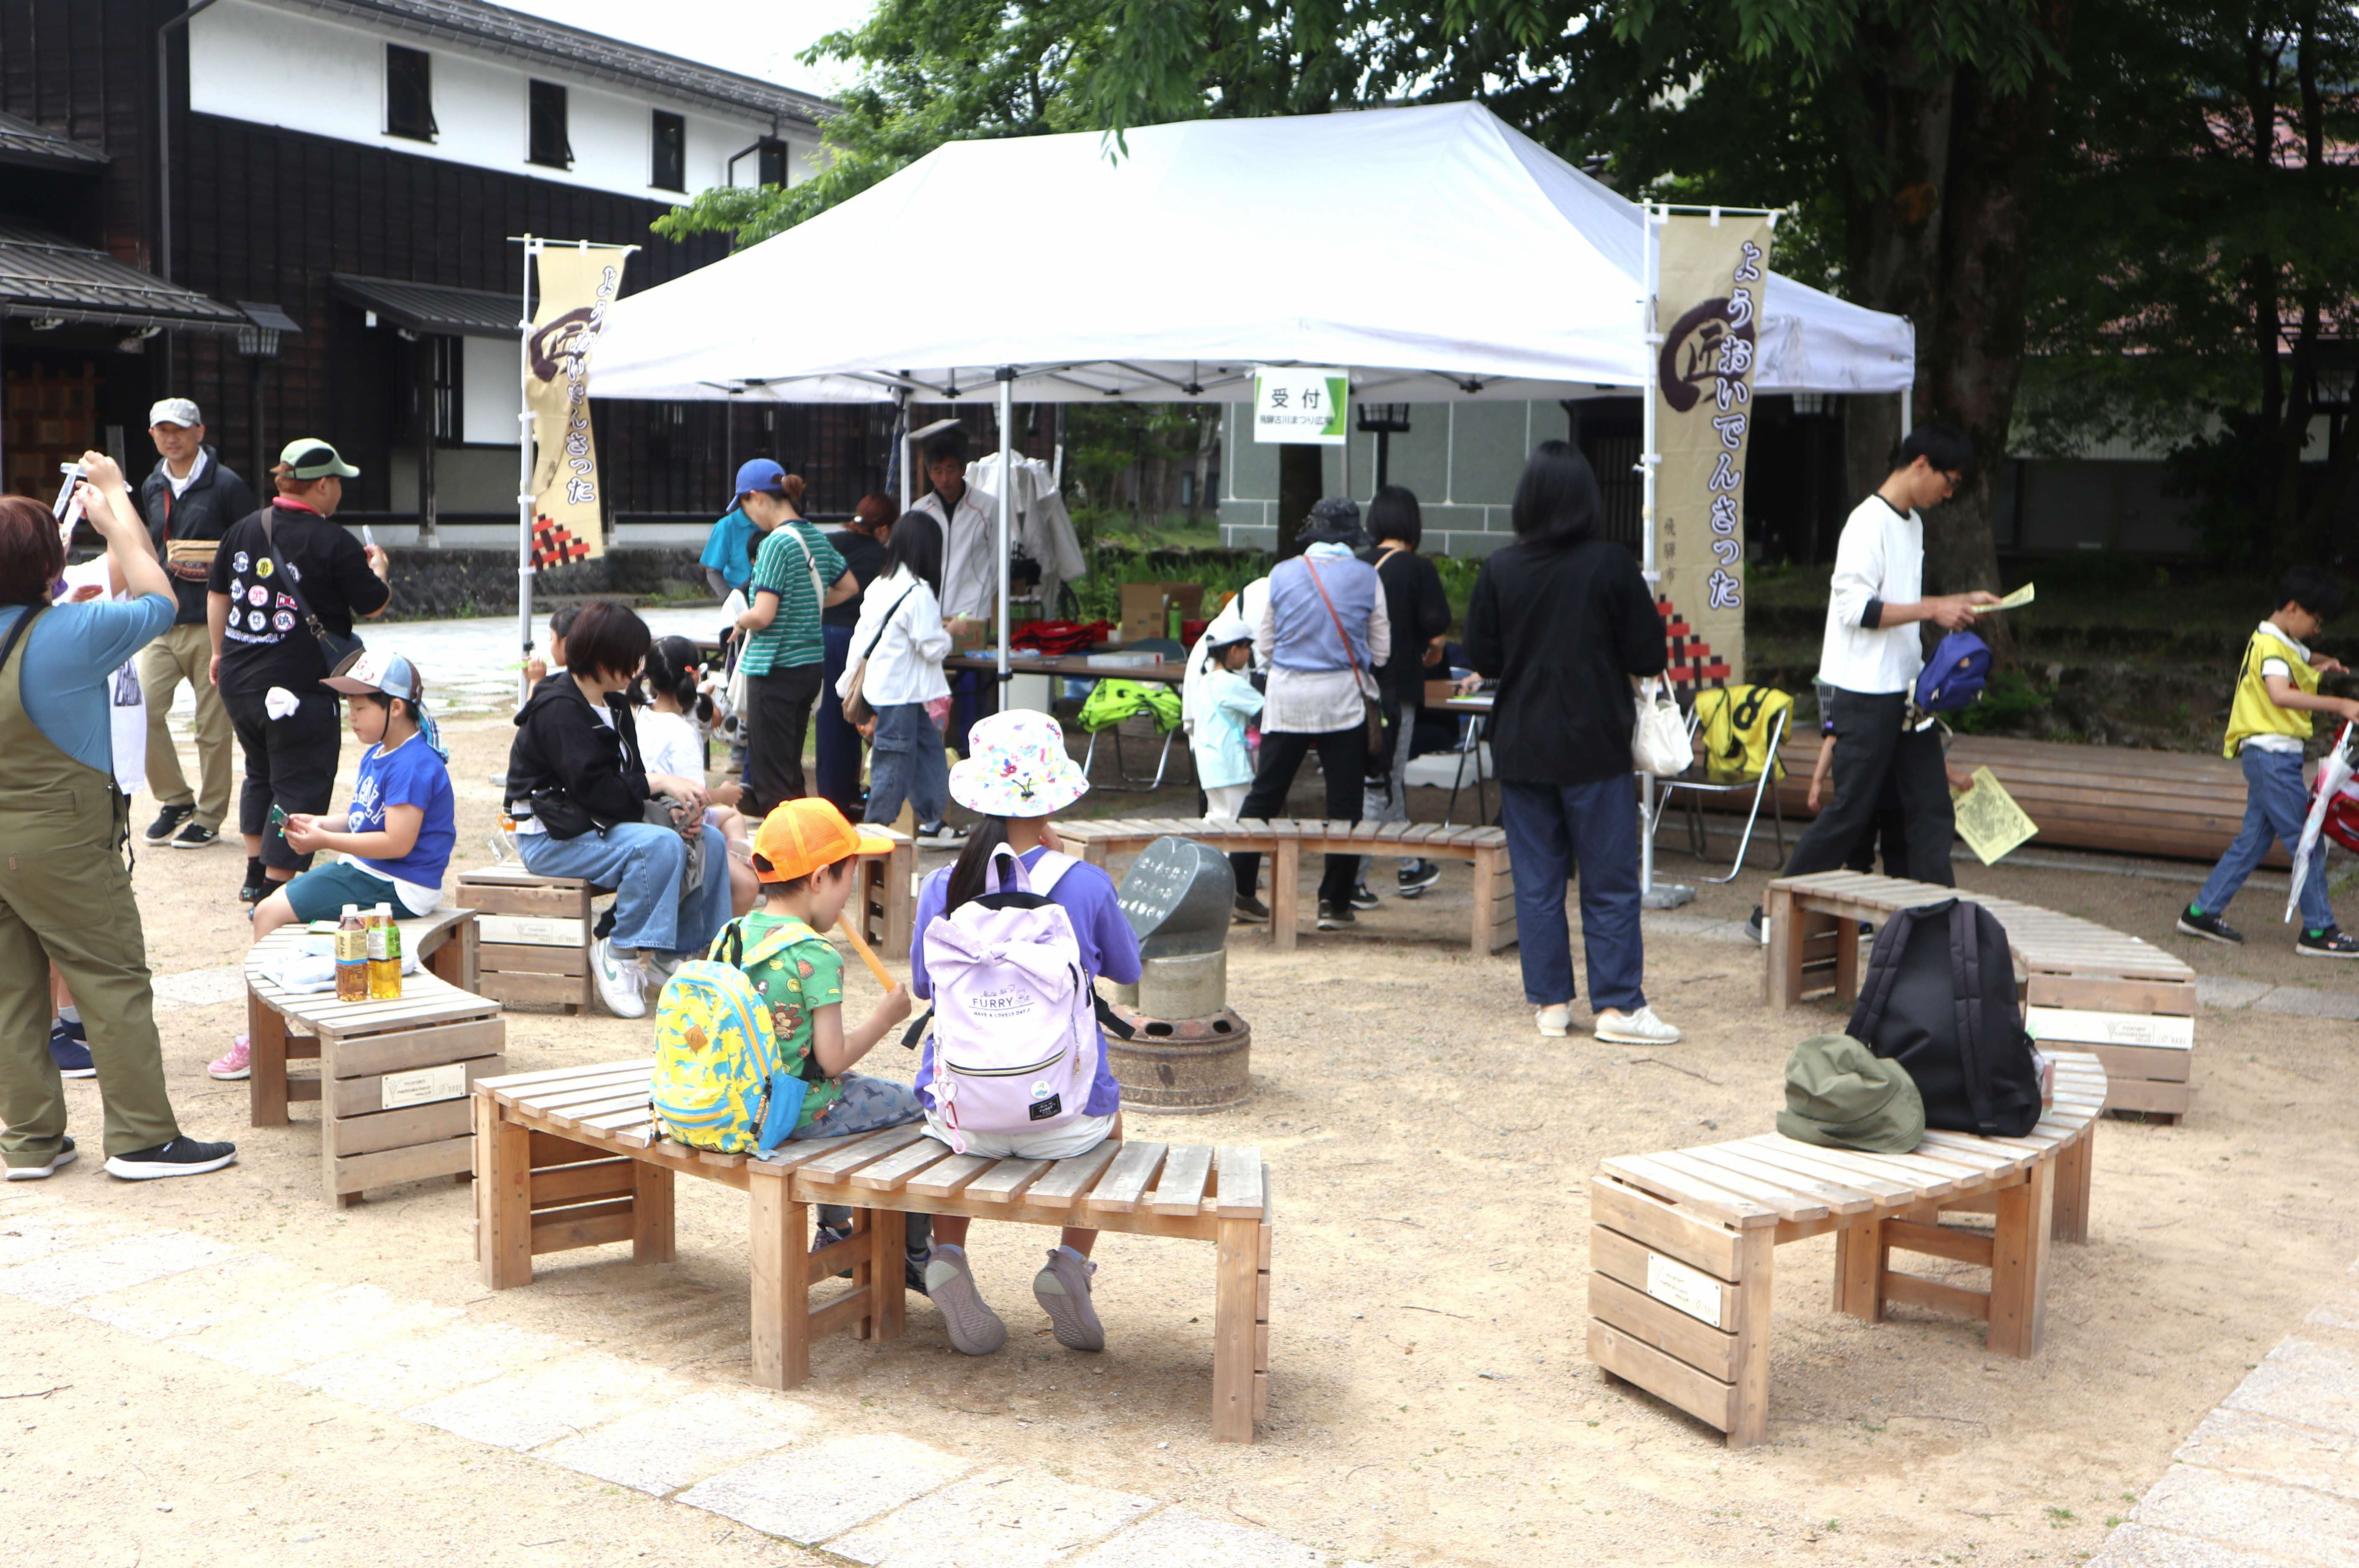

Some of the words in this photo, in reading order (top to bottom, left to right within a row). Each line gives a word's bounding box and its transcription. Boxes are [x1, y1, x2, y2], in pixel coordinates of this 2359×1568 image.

[1271, 387, 1320, 409] 受付
[1708, 240, 1762, 609] ようおいでんさった
[973, 997, 1013, 1008] FURRY
